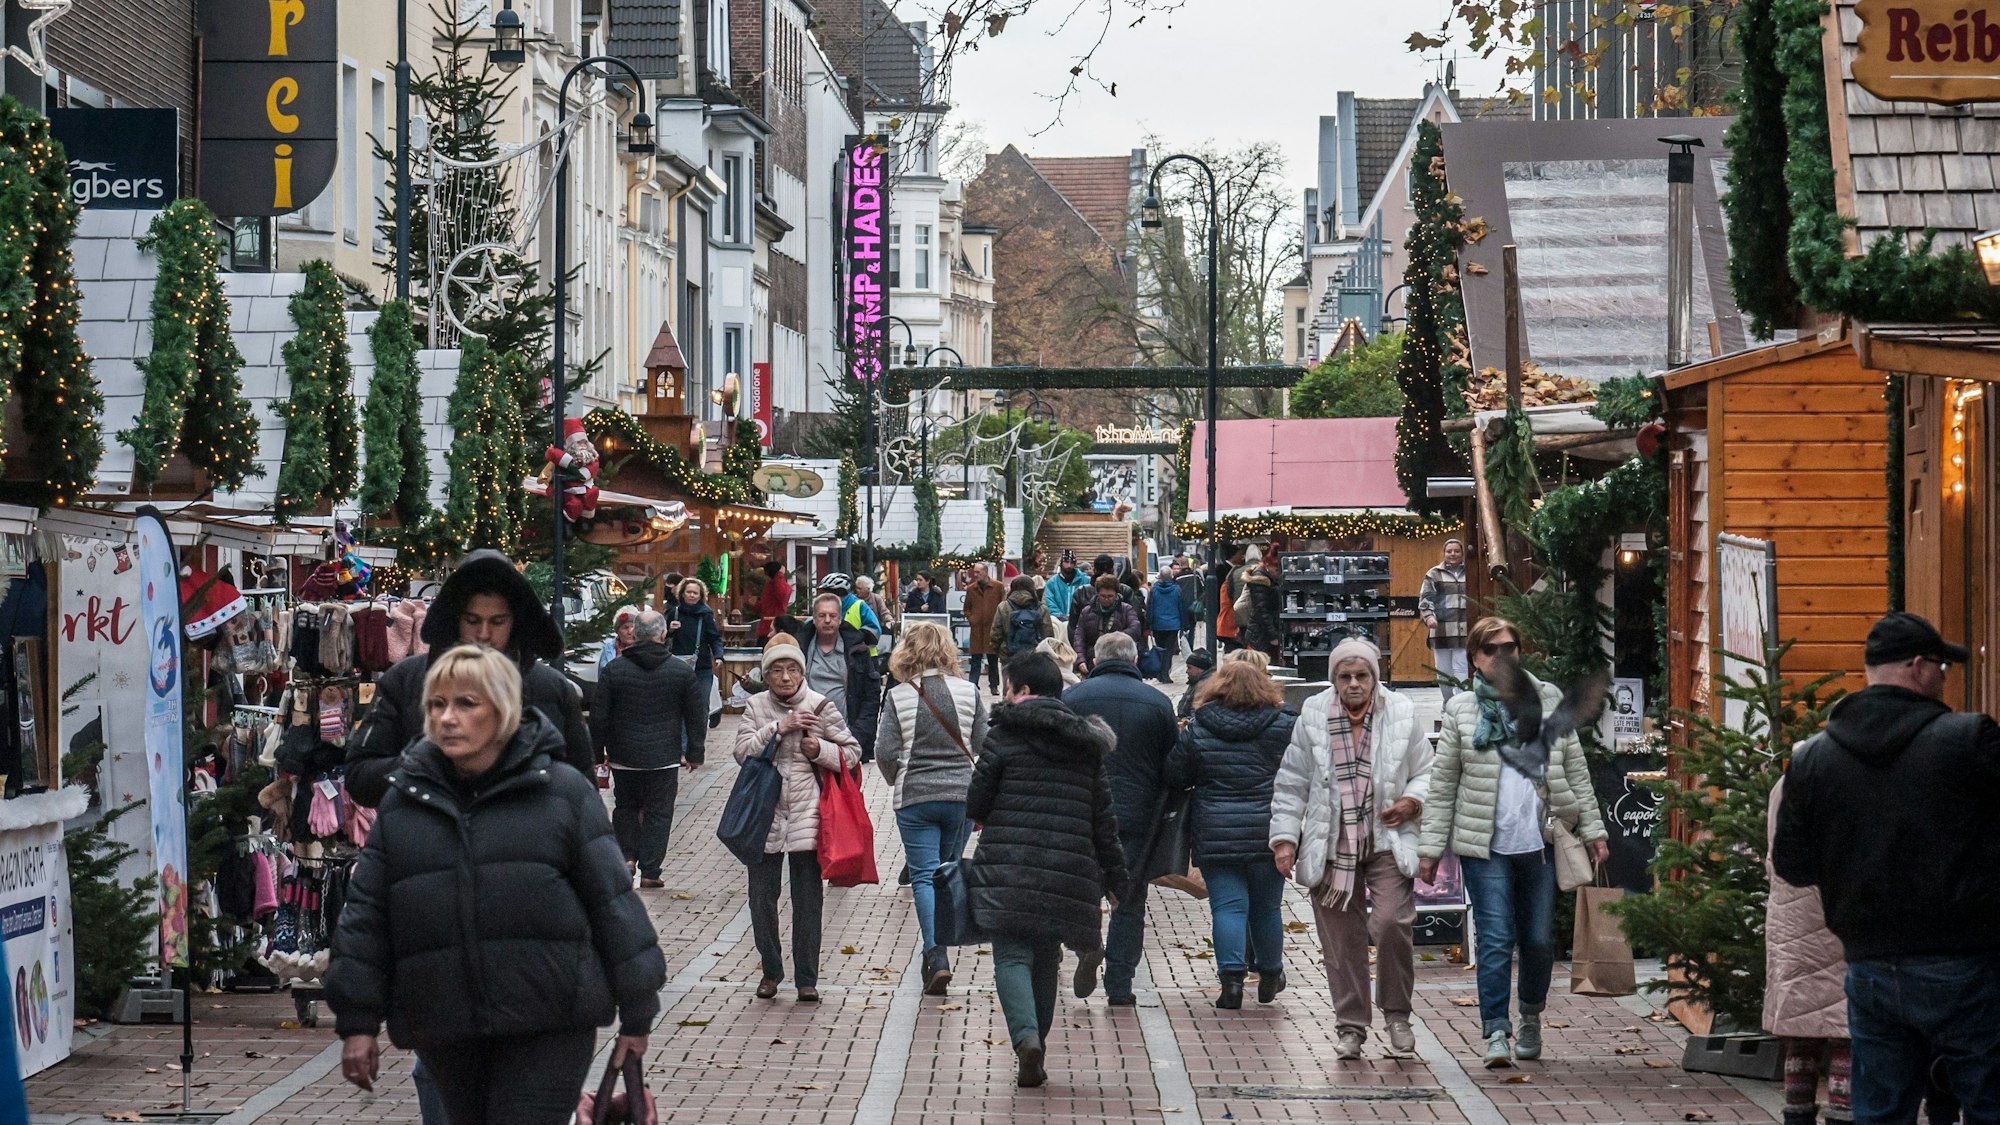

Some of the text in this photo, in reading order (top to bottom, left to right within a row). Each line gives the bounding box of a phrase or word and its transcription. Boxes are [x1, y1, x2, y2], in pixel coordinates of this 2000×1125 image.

[1886, 8, 2000, 63] Reib
[72, 172, 164, 204] gbers
[853, 146, 882, 382] OYMP & HADES
[62, 595, 136, 645] rkt
